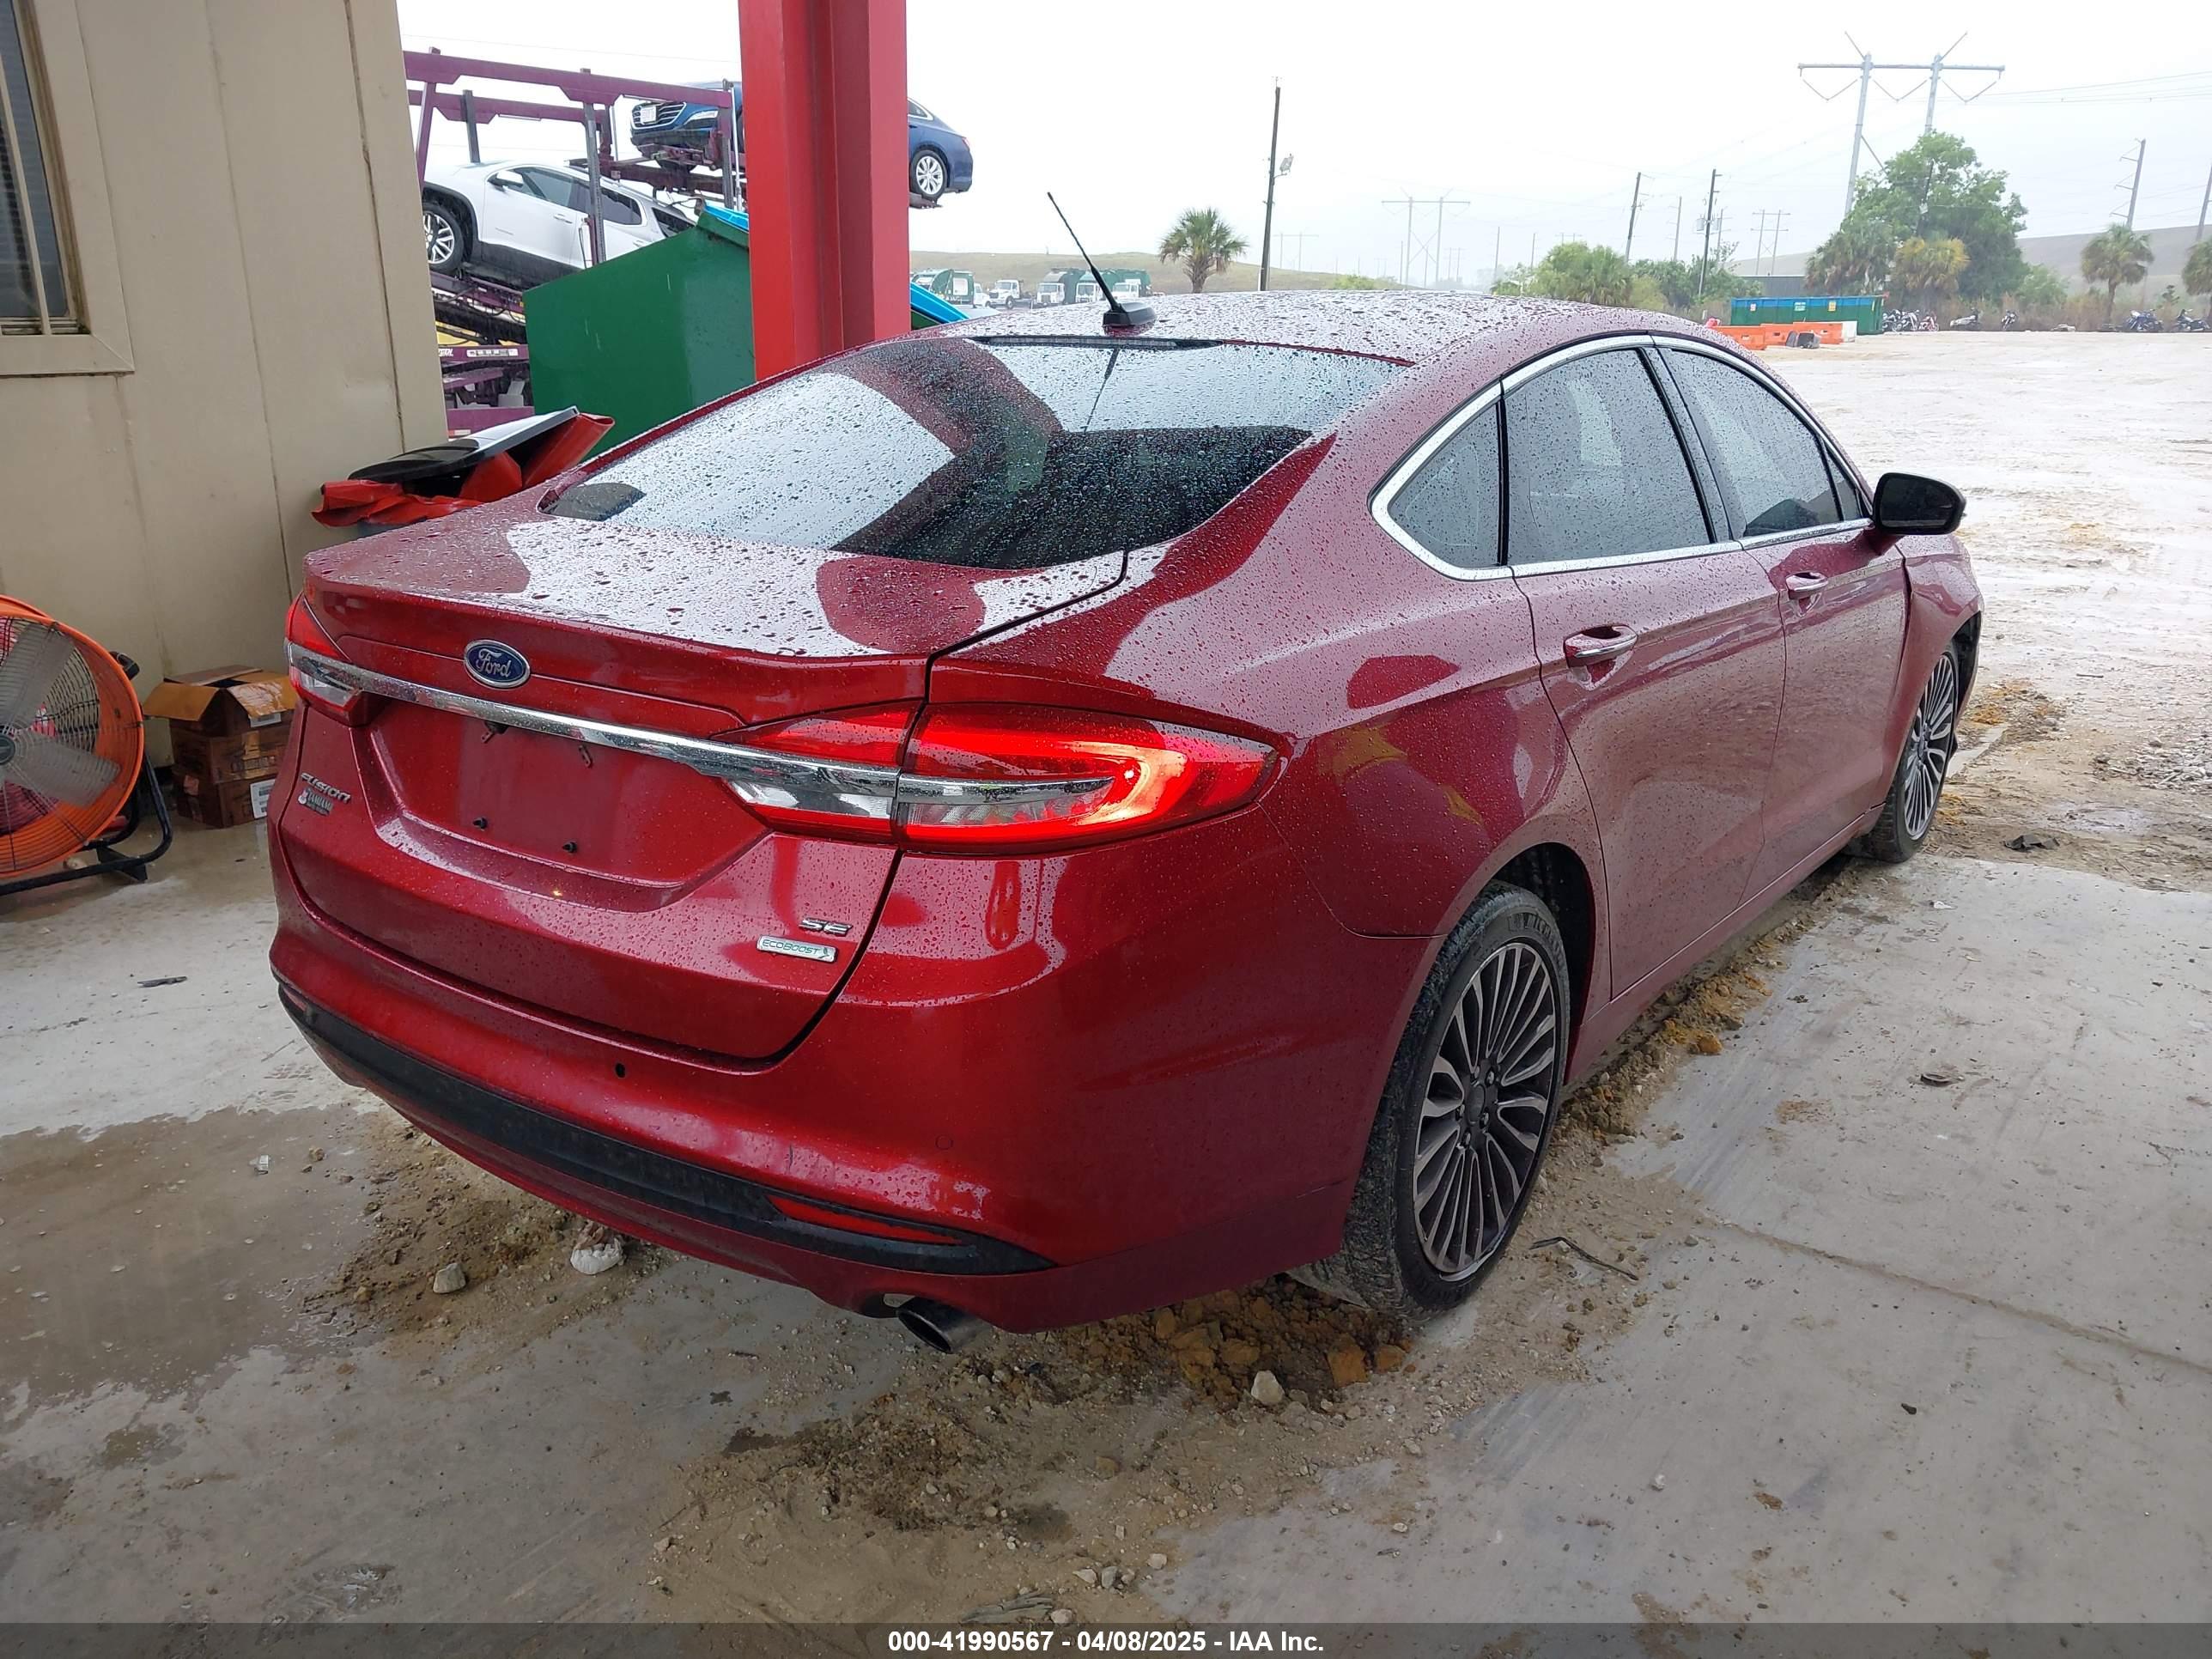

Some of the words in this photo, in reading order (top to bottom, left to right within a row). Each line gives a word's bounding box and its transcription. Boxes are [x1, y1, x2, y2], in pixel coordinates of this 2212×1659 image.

[476, 648, 511, 678] Ford
[301, 772, 351, 804] FUSION
[799, 917, 853, 936] SE
[763, 939, 821, 955] ECOBOOST
